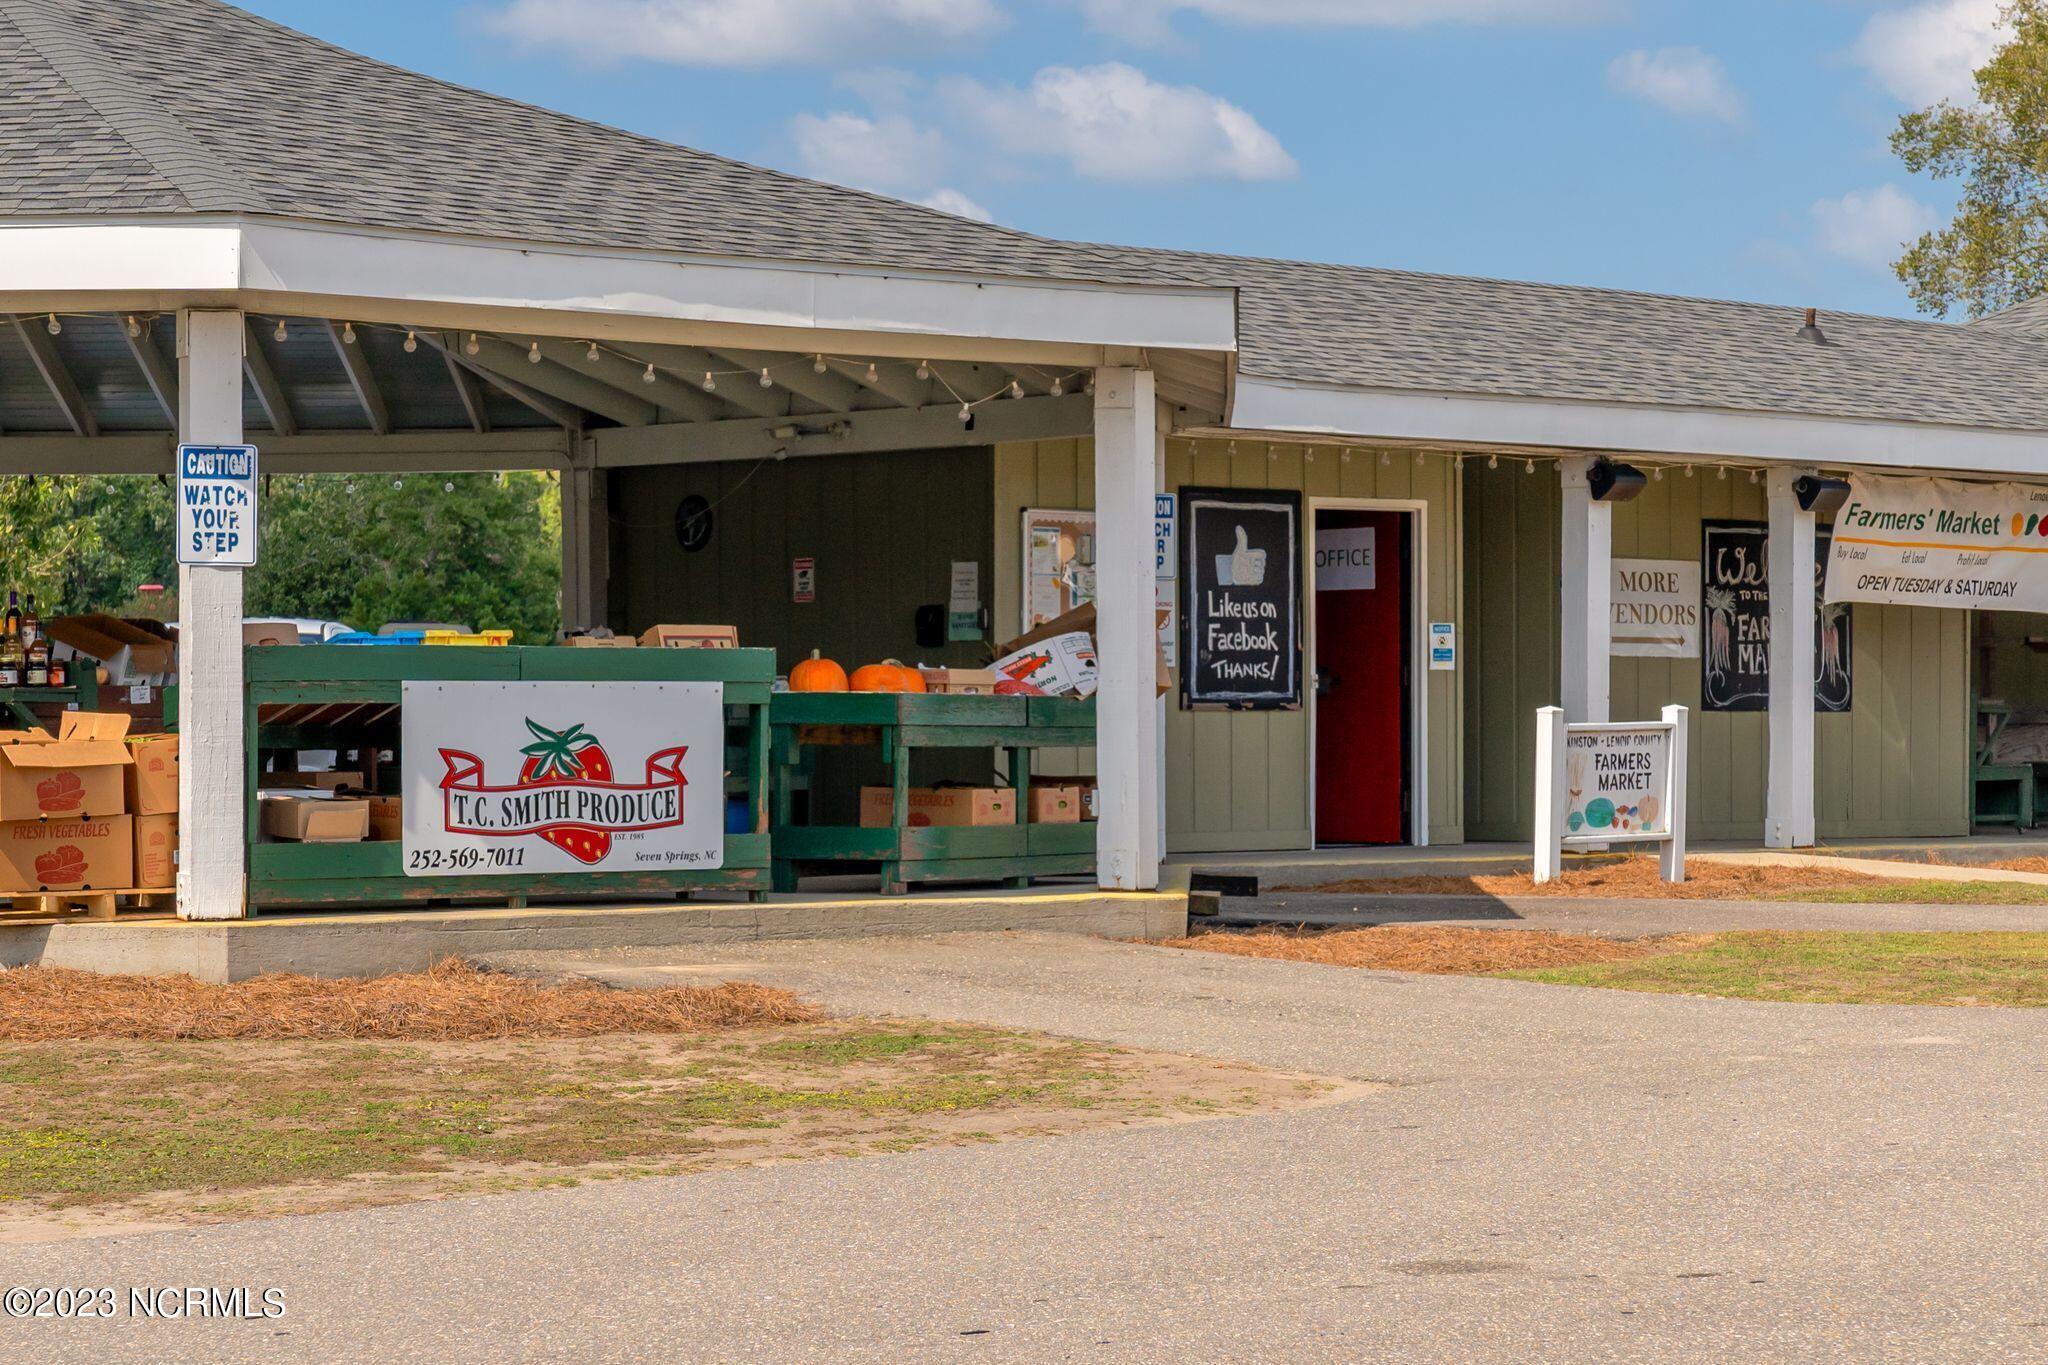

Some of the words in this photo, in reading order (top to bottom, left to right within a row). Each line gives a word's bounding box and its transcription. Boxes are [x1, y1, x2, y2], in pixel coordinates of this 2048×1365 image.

[187, 453, 249, 475] CAUTION
[184, 485, 248, 507] WATCH
[192, 508, 240, 530] YOUR
[1844, 502, 1934, 531] Farmers'
[1936, 509, 2000, 536] Market
[192, 531, 239, 553] STEP
[1837, 545, 1849, 560] Buy
[1849, 547, 1868, 561] Local
[1315, 548, 1371, 569] OFFICE
[1912, 551, 1928, 564] Local
[1956, 553, 1974, 566] Profit
[1619, 570, 1680, 594] MORE
[1857, 574, 1891, 592] OPEN
[1891, 576, 1944, 595] TUESDAY
[1944, 578, 1953, 595] &
[1955, 579, 2017, 598] SATURDAY
[1208, 590, 1242, 618] Like
[1242, 601, 1259, 619] us
[1260, 601, 1277, 619] on
[1739, 590, 1751, 601] TO
[1753, 590, 1769, 601] THE
[1207, 621, 1279, 652] Facebook
[1210, 654, 1280, 681] THANKS!
[1594, 752, 1651, 771] FARMERS
[1598, 771, 1652, 791] MARKET
[453, 793, 494, 827] T.C.
[501, 788, 571, 828] SMITH
[576, 789, 676, 824] PRODUCE
[13, 823, 46, 840] FRESH
[49, 822, 110, 839] VEGETABLES
[410, 846, 525, 870] 252-569-7011
[634, 851, 661, 862] Seven
[664, 850, 701, 864] Springs,
[704, 850, 717, 861] NC
